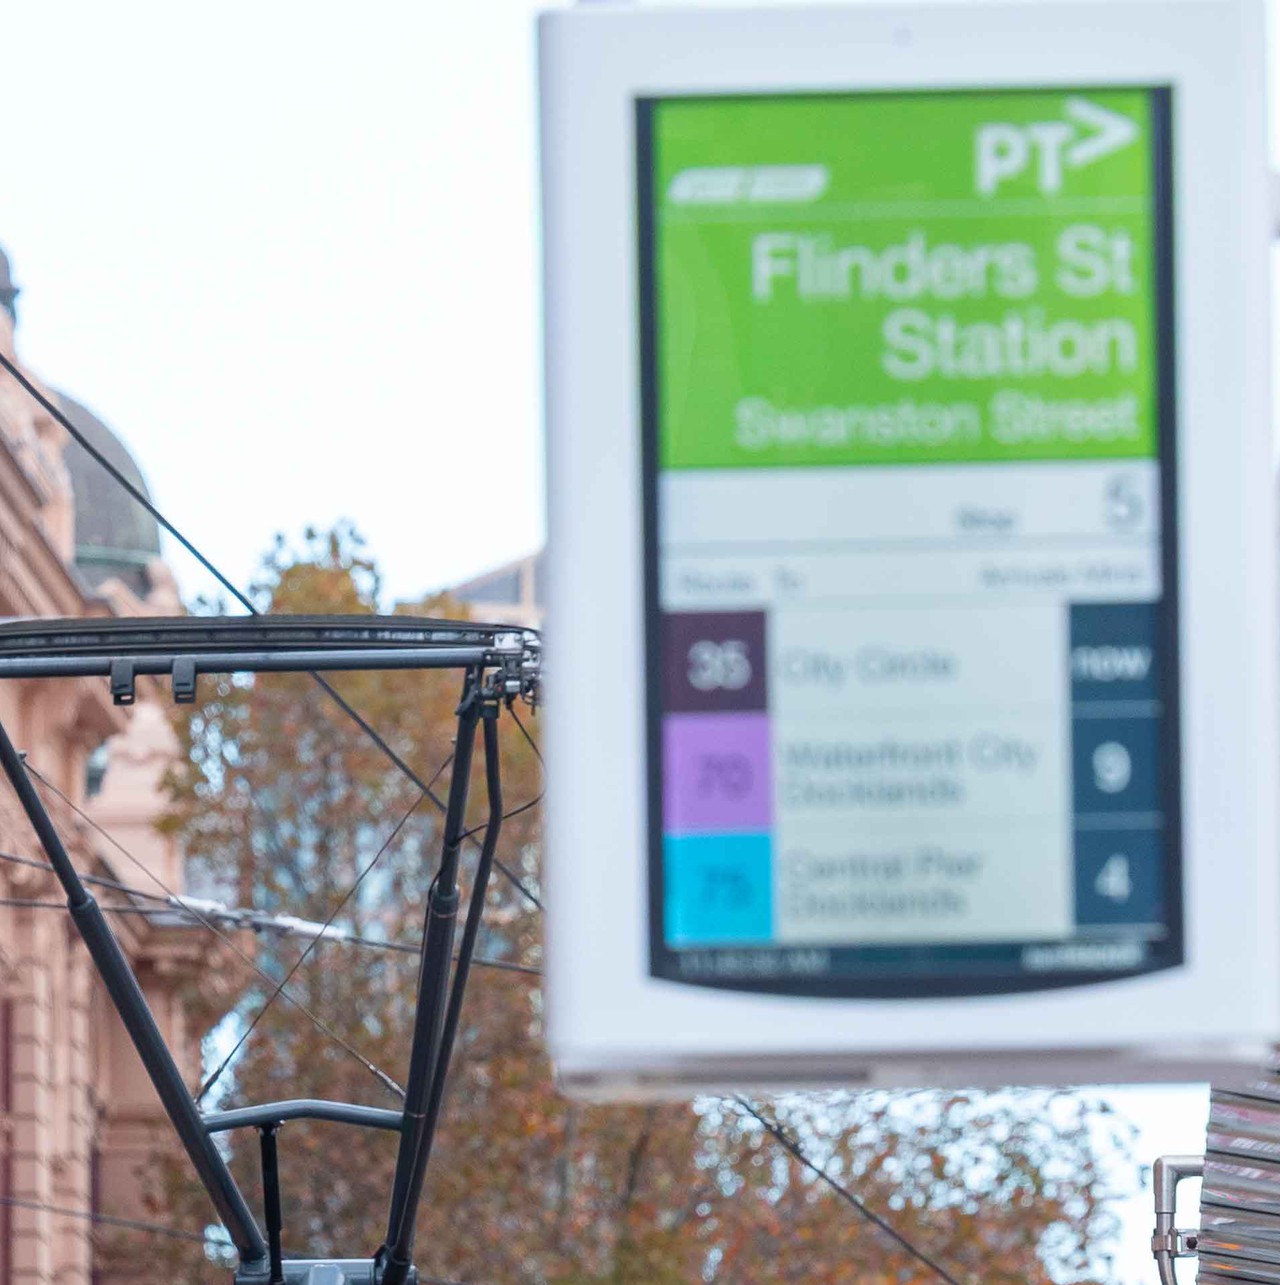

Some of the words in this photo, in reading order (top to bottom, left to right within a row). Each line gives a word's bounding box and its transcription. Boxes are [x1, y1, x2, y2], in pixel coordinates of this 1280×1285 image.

[751, 229, 1038, 302] Flinders
[1054, 222, 1137, 297] St
[880, 307, 1138, 381] Station
[733, 395, 980, 449] Swanston
[989, 389, 1140, 445] Street
[686, 639, 754, 692] 35
[1095, 854, 1133, 902] 4
